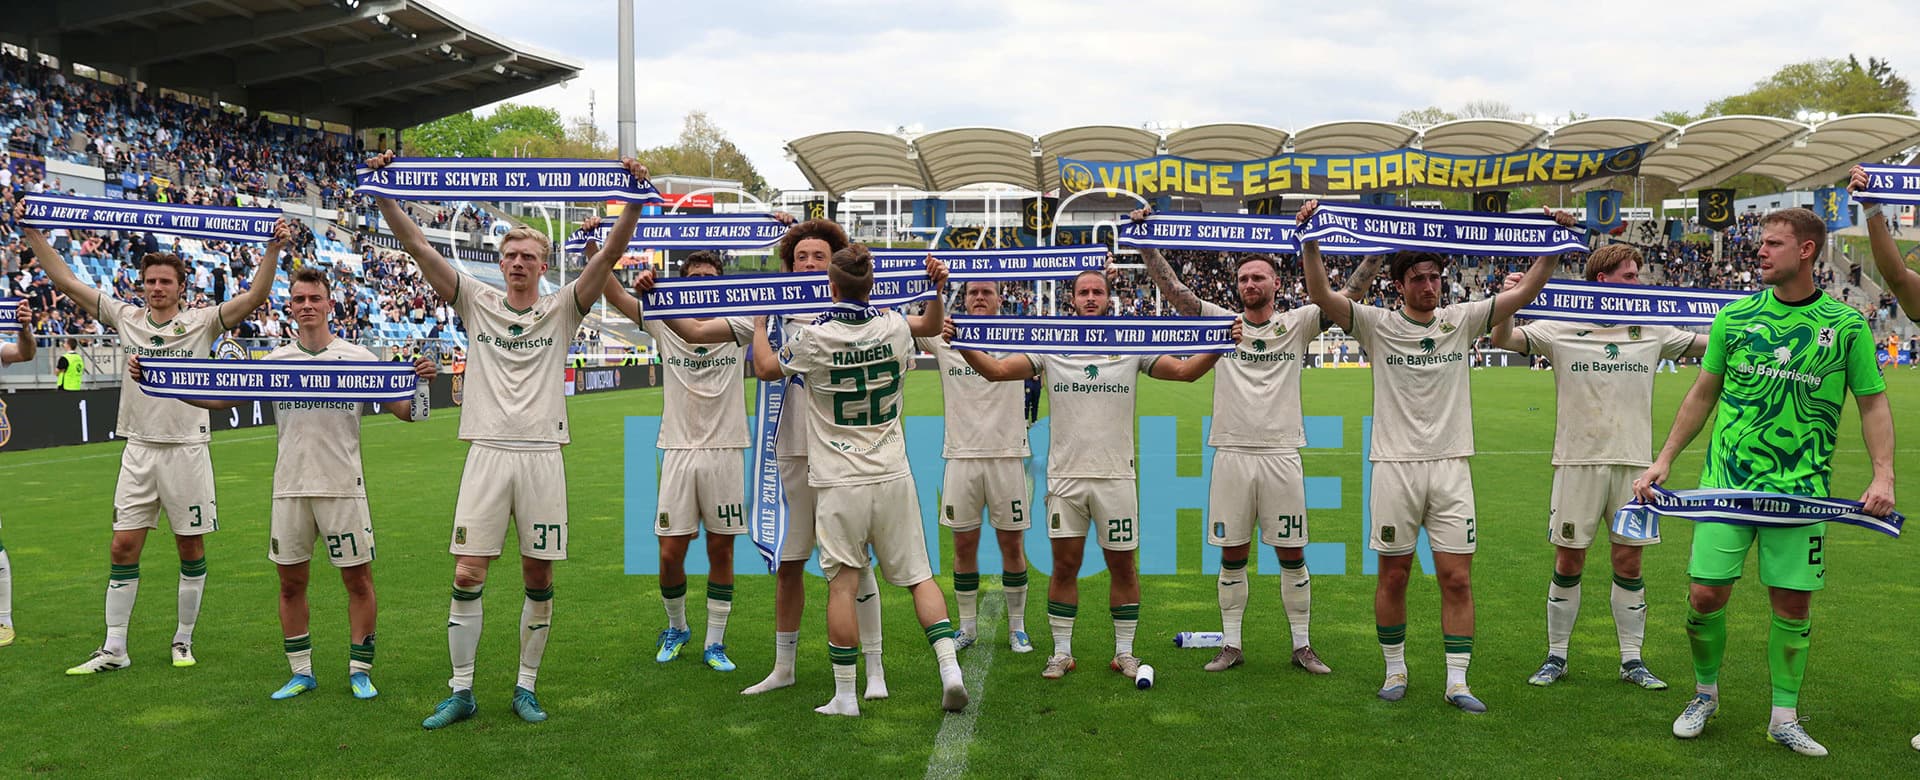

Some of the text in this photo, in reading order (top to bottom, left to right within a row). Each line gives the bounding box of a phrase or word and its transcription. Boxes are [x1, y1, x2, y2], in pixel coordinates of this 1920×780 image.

[362, 171, 389, 185] AS
[395, 171, 438, 186] HEUTE
[445, 172, 498, 187] SCHWER
[505, 172, 530, 188] IST,
[538, 172, 571, 187] WIRD
[578, 173, 631, 188] MORGEN
[1099, 151, 1605, 198] VIRAGE EST SAARBRÜCKEN
[1705, 193, 1728, 223] 3
[51, 207, 90, 221] HEUTE
[93, 209, 138, 224] SCHWER
[144, 212, 164, 226] IST,
[171, 215, 199, 229] WIRD
[205, 217, 249, 232] MORGEN
[1319, 212, 1358, 230] HEUTE
[1364, 217, 1417, 236] SCHWER
[1423, 224, 1447, 239] IST,
[1454, 225, 1487, 241] WIRD
[1495, 227, 1546, 243] MORGEN
[643, 226, 672, 238] WIRD
[706, 226, 751, 238] SCHWER
[1153, 224, 1192, 238] HEUTE
[1197, 226, 1246, 240] SCHWER
[1251, 227, 1274, 241] IST,
[972, 258, 993, 270] IST,
[999, 256, 1027, 269] WIRD
[1032, 255, 1077, 269] MORGEN
[648, 291, 674, 306] WAS
[680, 289, 720, 305] HEUTE
[726, 287, 776, 303] SCHWER
[782, 286, 806, 301] IST,
[812, 284, 832, 299] WI
[870, 280, 900, 297] RGEN
[1530, 293, 1719, 315] AS HEUTE SCHWER IST, WIRD
[477, 331, 553, 351] die Bayerische
[956, 326, 1232, 344] WAS HEUTE SCHWER IST, WIRD MORGEN GUT!
[124, 346, 194, 359] die Bayerische
[667, 355, 737, 369] die Bayerische
[832, 344, 894, 365] HAUGEN
[1240, 350, 1295, 364] Bayerische
[1387, 354, 1404, 366] die
[1407, 350, 1463, 367] Bayerische
[948, 366, 963, 377] die
[1571, 361, 1649, 374] die Bayerische
[1738, 362, 1822, 386] die Bayerische
[141, 369, 416, 390] WAS HEUTE SCHWER IST, WIRD MORGEN GUT!
[1053, 382, 1130, 396] die Bayerische
[830, 361, 900, 426] 22
[294, 401, 354, 412] Bayerische
[189, 505, 202, 527] 3
[717, 504, 744, 527] 44
[1011, 500, 1023, 522] 5
[1752, 497, 1790, 514] WIRD
[533, 523, 561, 551] 37
[1108, 518, 1133, 542] 29
[1278, 515, 1303, 538] 34
[327, 532, 358, 558] 27
[1808, 536, 1826, 565] 2
